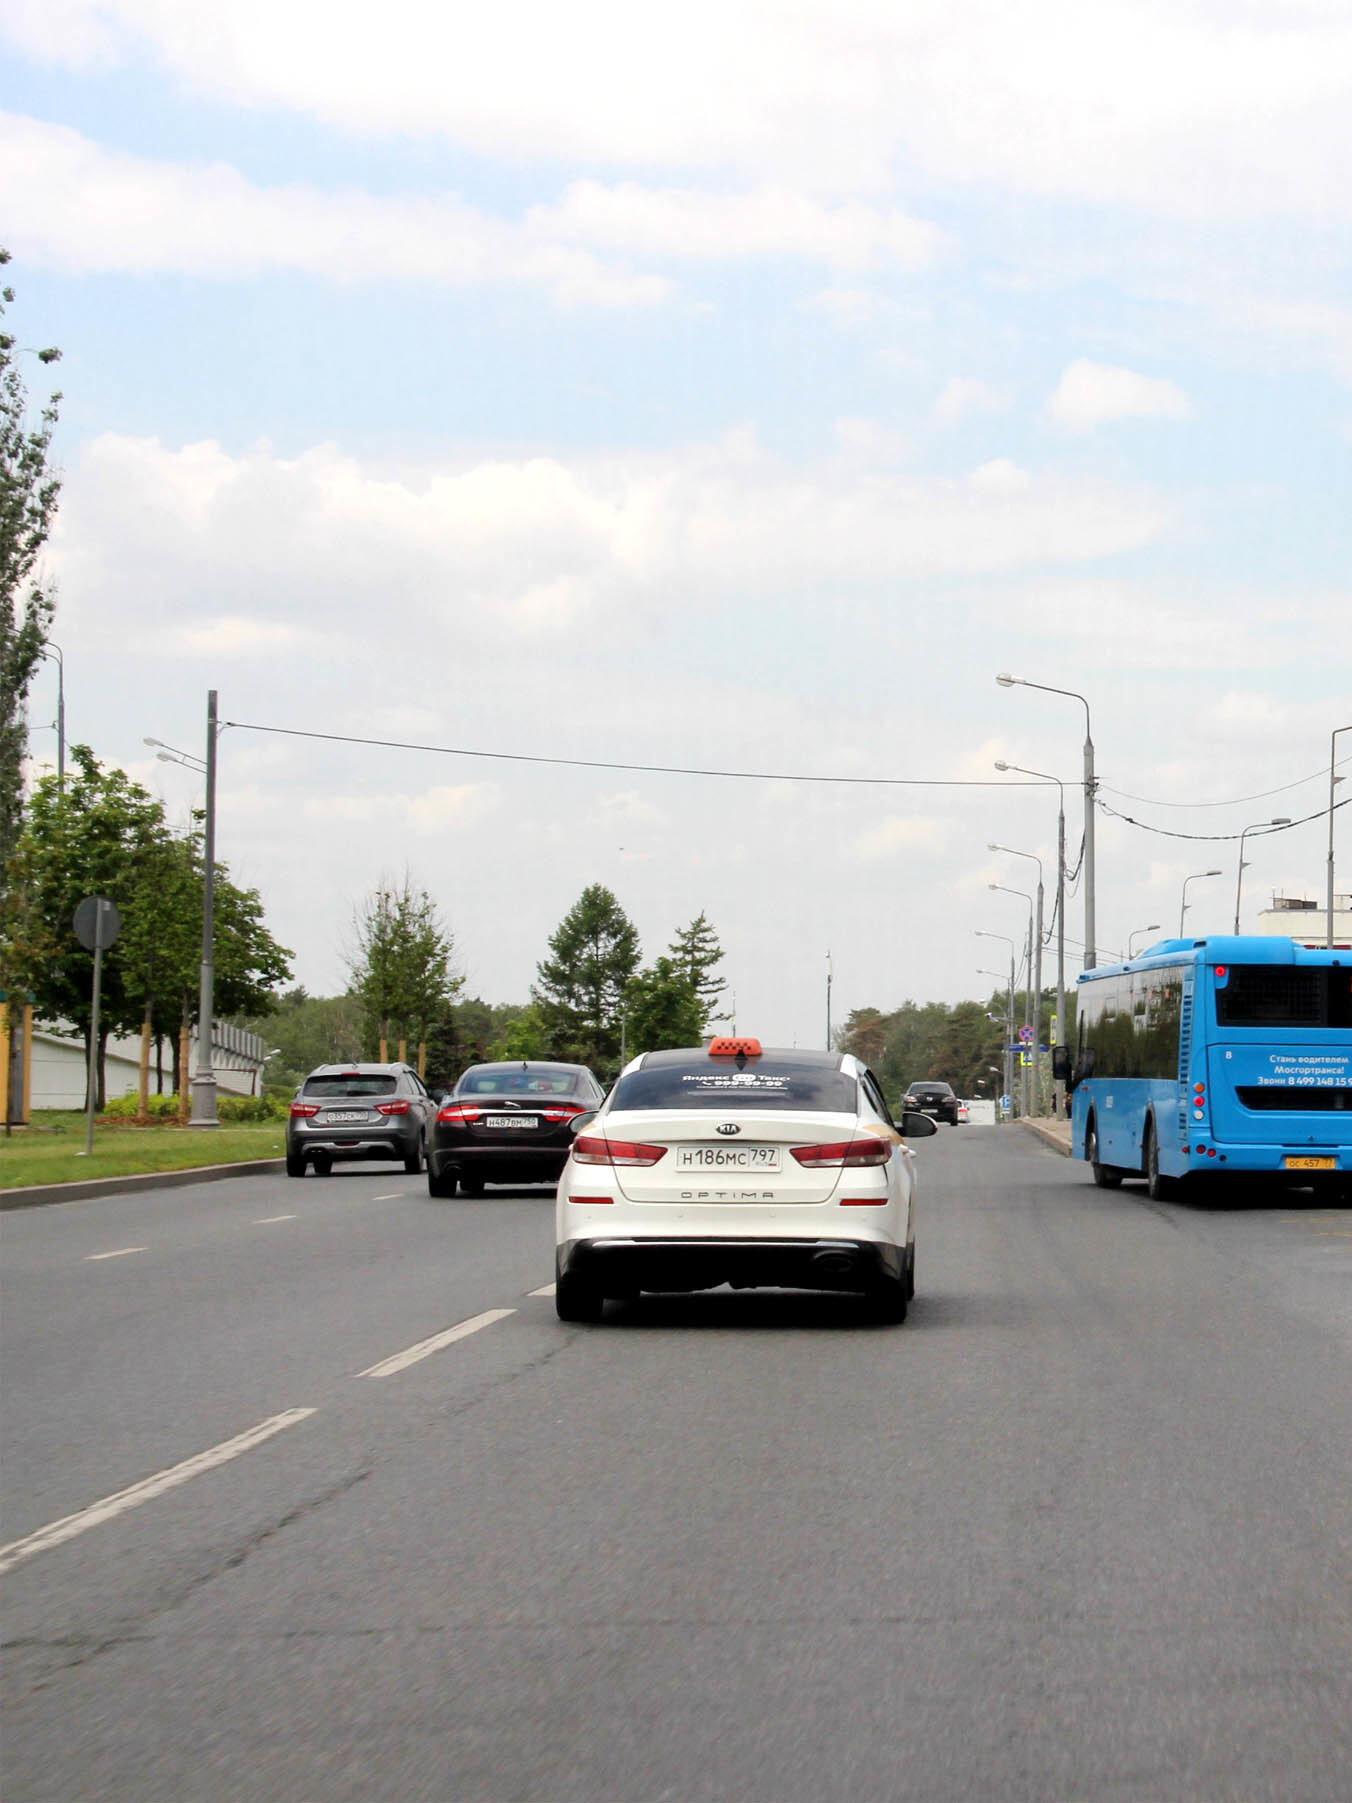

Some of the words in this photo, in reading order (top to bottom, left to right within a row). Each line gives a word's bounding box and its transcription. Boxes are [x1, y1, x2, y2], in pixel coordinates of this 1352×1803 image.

[1269, 1054, 1297, 1063] Стань
[1298, 1056, 1350, 1064] водителем
[1274, 1066, 1345, 1075] Мосгортранса!
[1257, 1076, 1286, 1085] Звони
[1287, 1076, 1295, 1085] 8
[1296, 1077, 1314, 1085] 499
[1316, 1077, 1333, 1086] 148
[1335, 1077, 1347, 1086] 15
[719, 1125, 737, 1133] KIA
[682, 1149, 747, 1165] Н186МС
[750, 1149, 776, 1161] 797
[681, 1191, 774, 1199] OPTIMA
